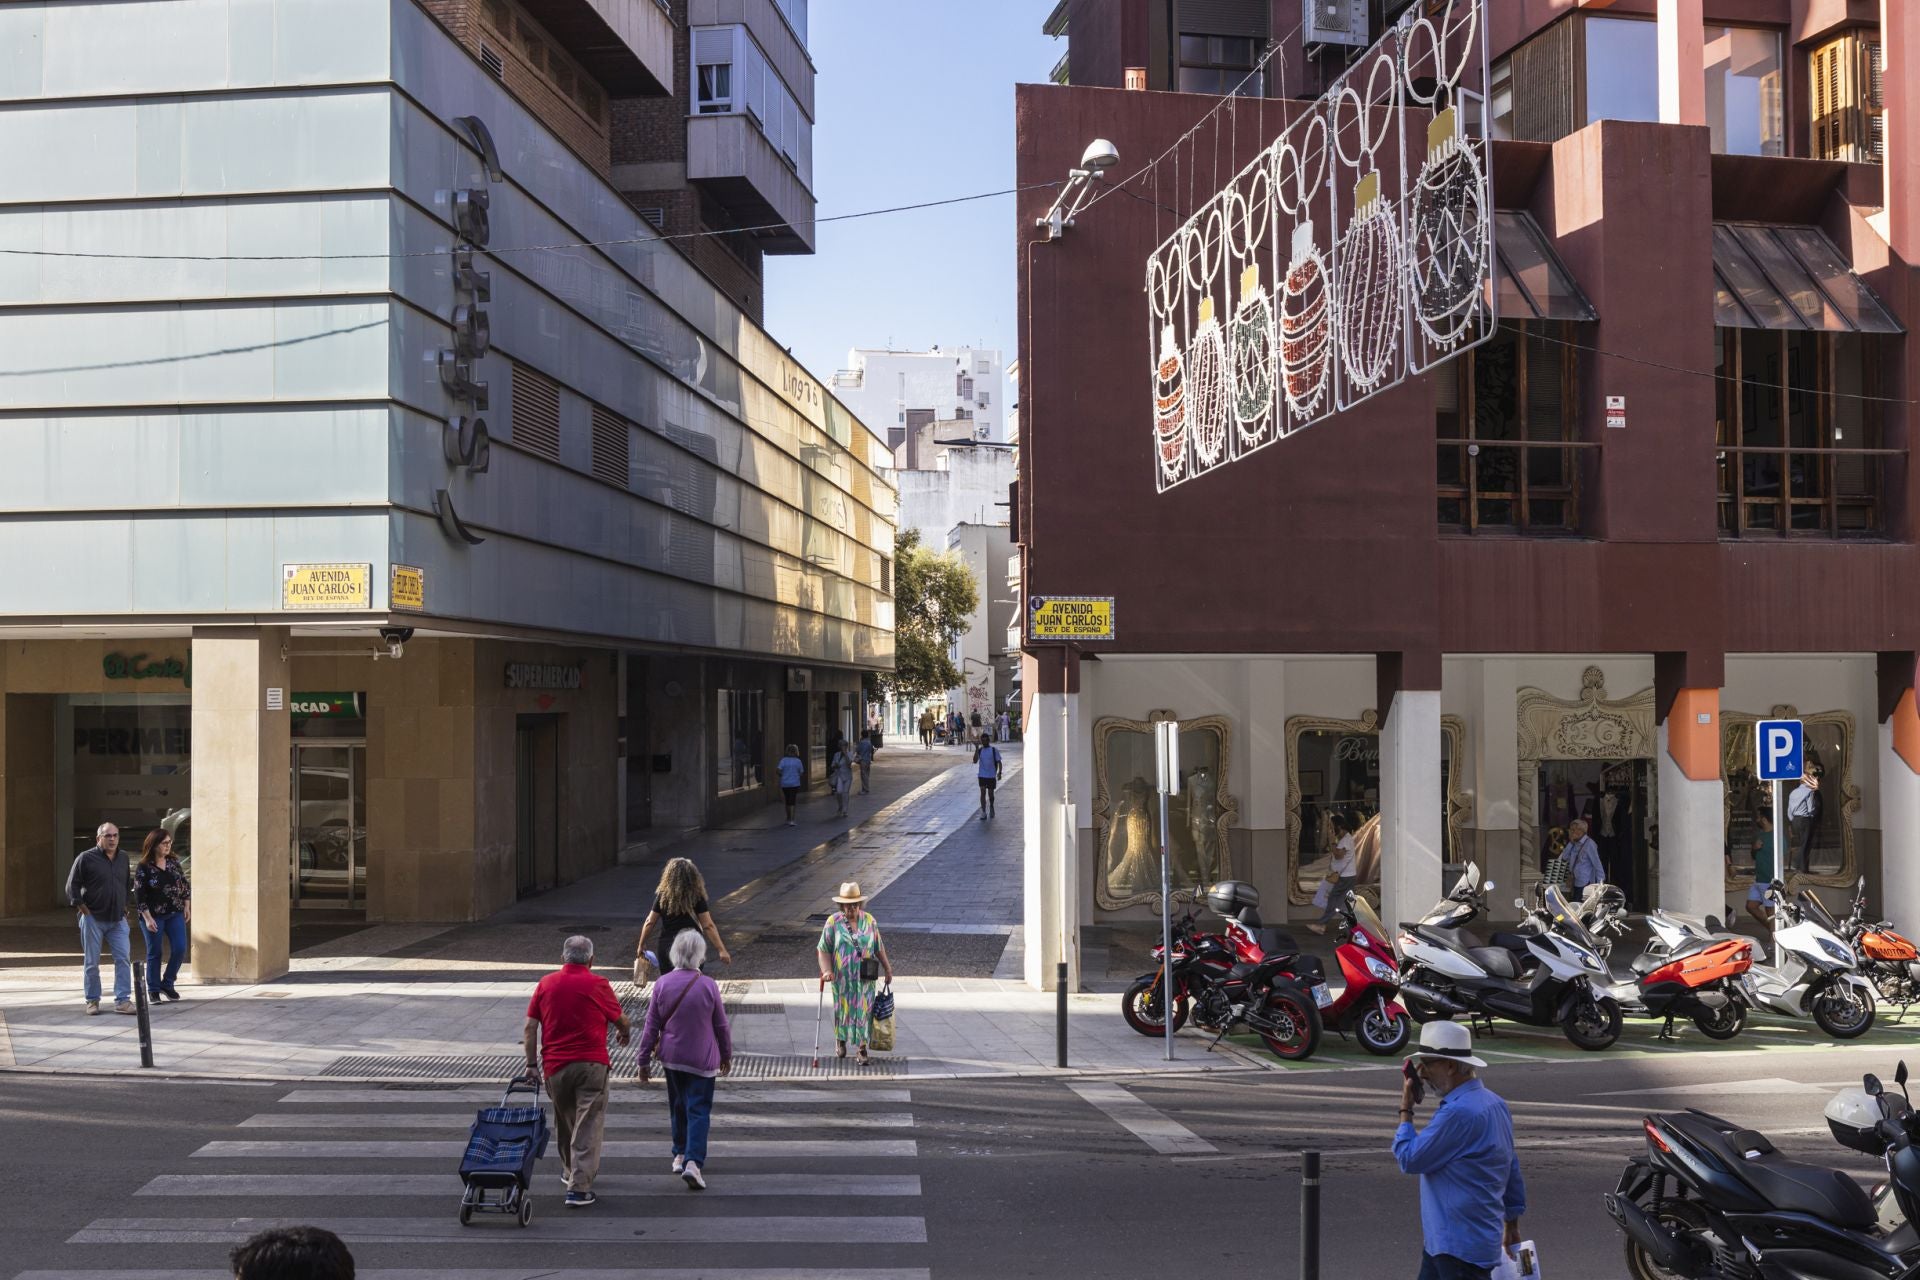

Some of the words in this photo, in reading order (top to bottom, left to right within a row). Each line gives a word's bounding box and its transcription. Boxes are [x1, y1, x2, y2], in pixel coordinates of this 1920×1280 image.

[309, 570, 351, 582] AVENIDA
[290, 583, 316, 595] JUAN
[317, 582, 356, 594] CARLOS
[358, 583, 362, 594] I
[1052, 603, 1093, 614] AVENIDA
[1036, 614, 1062, 626] JUAN
[1065, 614, 1103, 626] CARLOS
[1104, 615, 1107, 626] I
[1768, 728, 1794, 773] P
